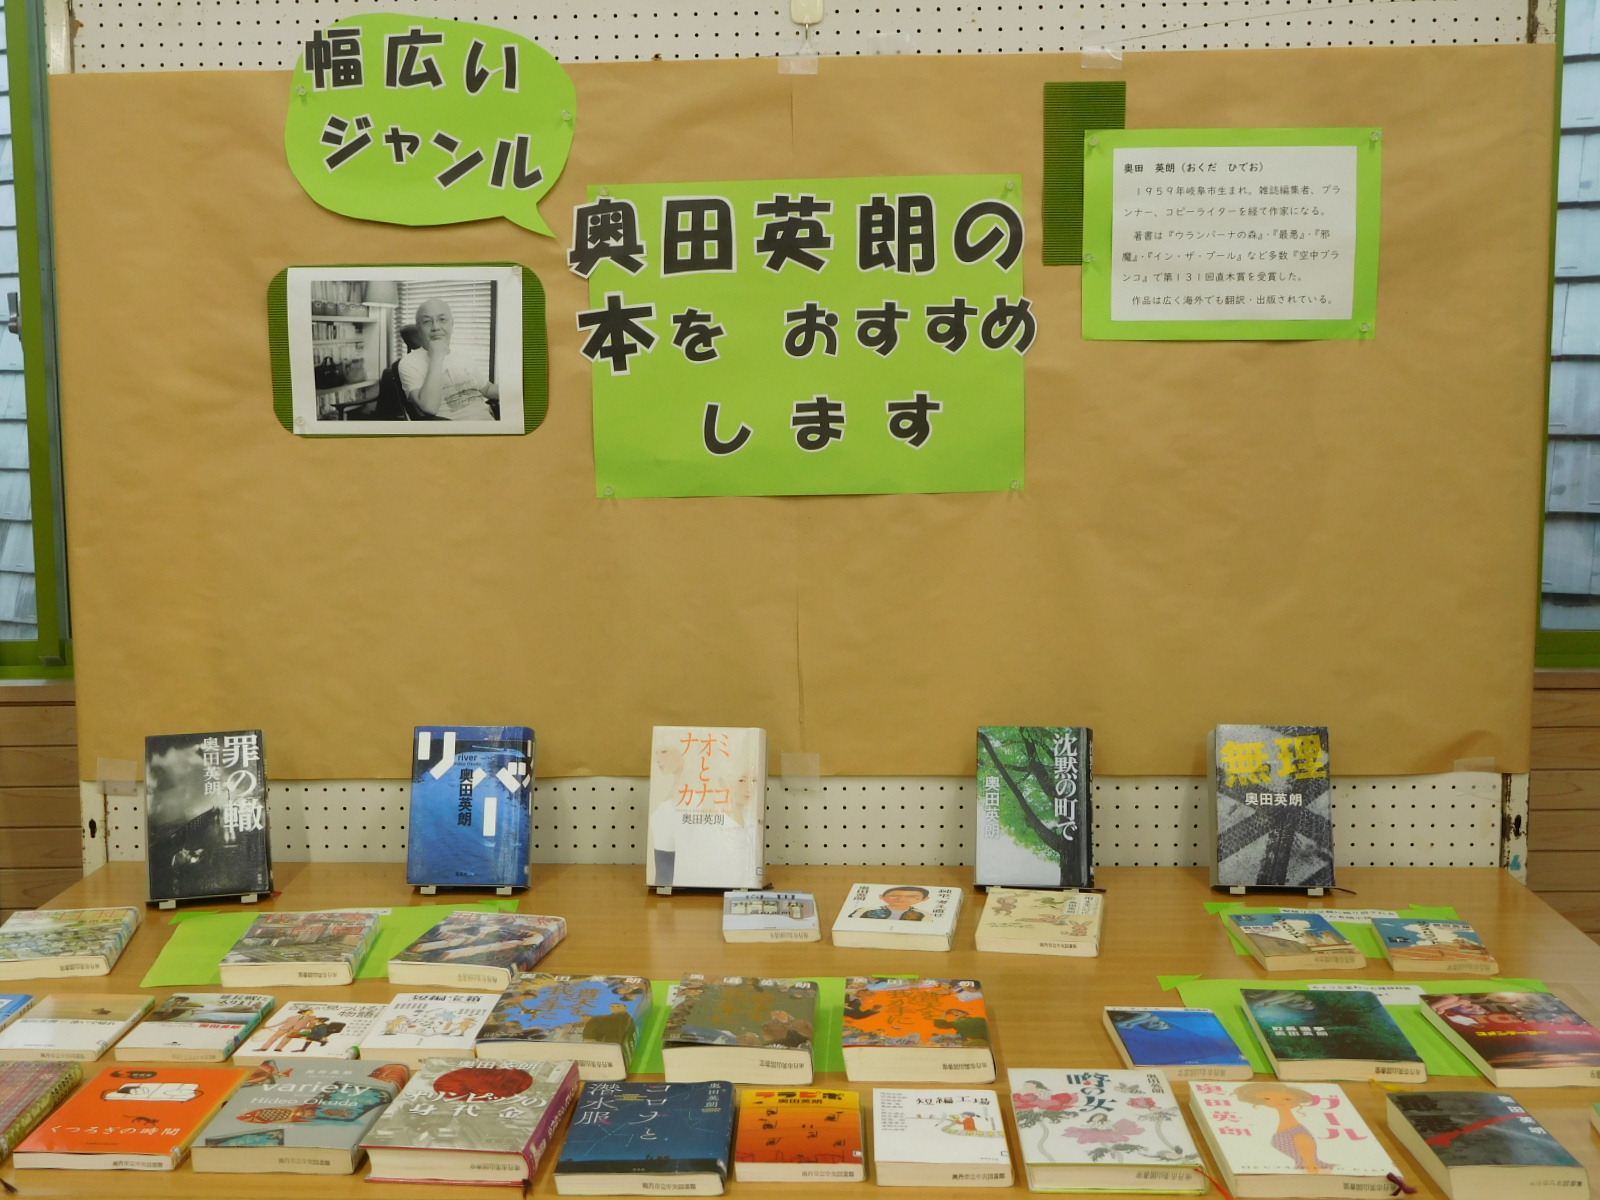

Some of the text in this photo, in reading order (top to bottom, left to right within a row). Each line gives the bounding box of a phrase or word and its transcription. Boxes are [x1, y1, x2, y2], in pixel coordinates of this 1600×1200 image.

[304, 26, 520, 95] 幅広い
[320, 113, 544, 191] ジャンル
[1124, 163, 1144, 173] 奥田
[566, 193, 1026, 278] 奥田英朗の
[577, 290, 1038, 376] 本を おすすめ
[702, 389, 943, 457] します
[201, 737, 222, 796] 奥田英朗
[679, 732, 730, 757] ナオミ
[1219, 734, 1328, 788] 無理
[222, 734, 265, 833] 罪の轍
[699, 756, 711, 782] と
[1053, 733, 1079, 841] 沈黙の町で
[457, 768, 474, 827] 奥田英朗
[675, 783, 731, 808] カナコ
[681, 813, 725, 826] 奥田英朗
[985, 775, 1001, 840] 奥田英朗
[1244, 792, 1303, 807] 奥田英朗
[262, 1081, 373, 1097] variety
[457, 1060, 539, 1071] 奥田英朗
[250, 1096, 359, 1107] Hideo Okuda
[404, 1089, 548, 1108] オリンピックの
[574, 1083, 623, 1125] 潜水服
[1195, 1083, 1253, 1137] 奥田英朗
[1304, 1094, 1369, 1142] ガール
[50, 1124, 183, 1137] くつろぎの時間
